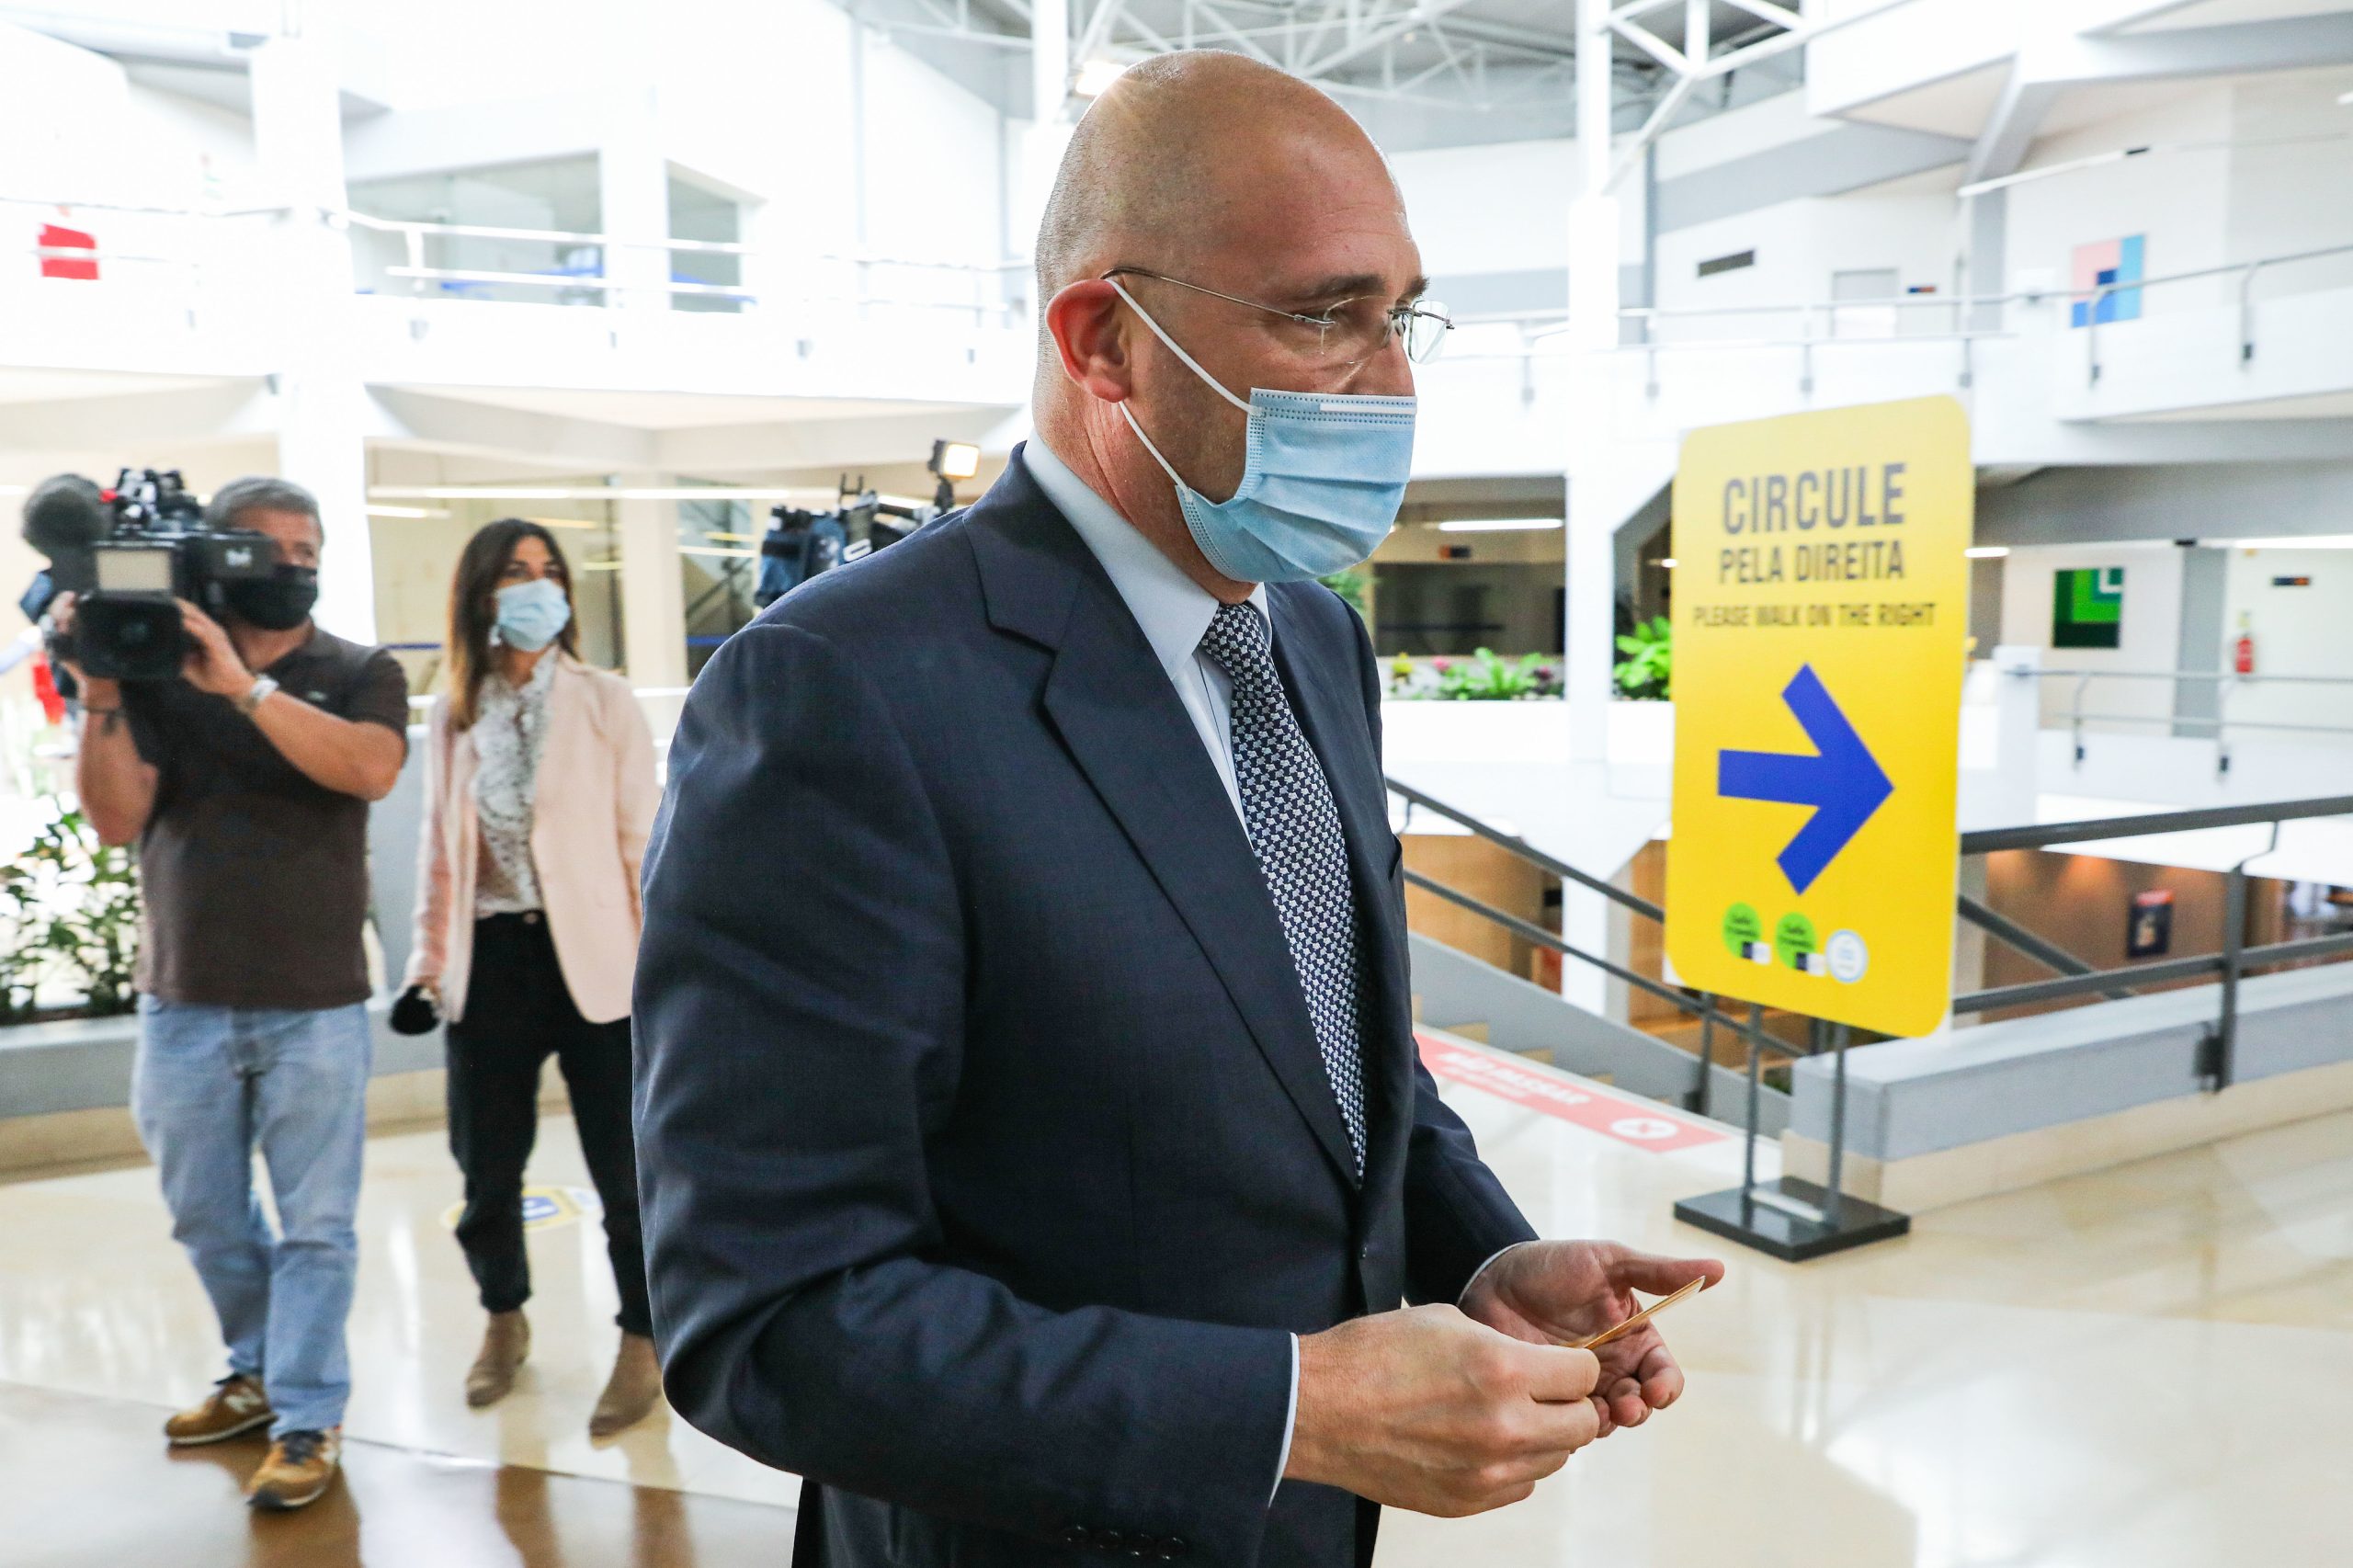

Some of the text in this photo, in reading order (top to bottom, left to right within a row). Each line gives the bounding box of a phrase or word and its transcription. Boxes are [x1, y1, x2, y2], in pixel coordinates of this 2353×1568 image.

[1722, 461, 1906, 535] CIRCULE
[1719, 540, 1905, 584] PELA DIREITA
[1693, 602, 1936, 627] PLEASE WALK ON THE RIGHT
